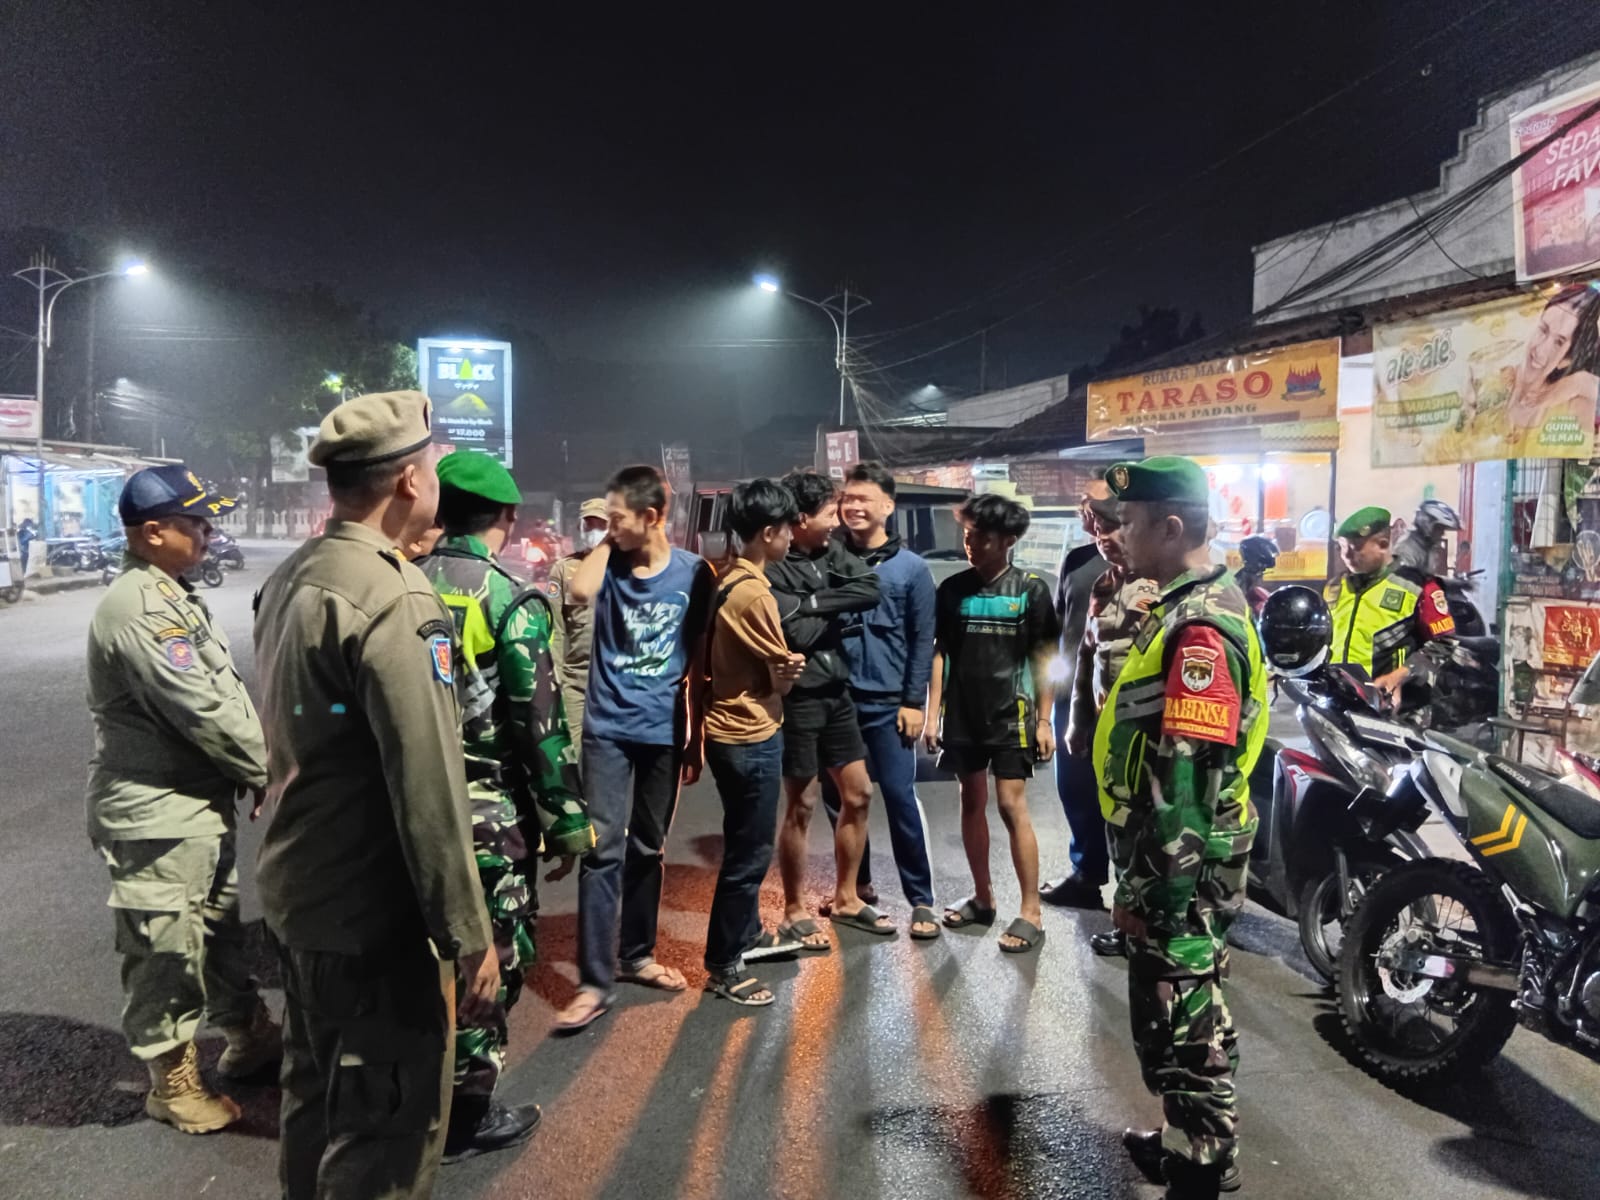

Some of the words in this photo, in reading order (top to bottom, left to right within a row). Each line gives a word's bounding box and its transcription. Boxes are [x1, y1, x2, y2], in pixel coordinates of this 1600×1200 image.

[1551, 150, 1600, 191] FAV
[1116, 370, 1273, 416] TARASO
[1191, 403, 1258, 418] PADANG
[1496, 762, 1531, 788] HONDA
